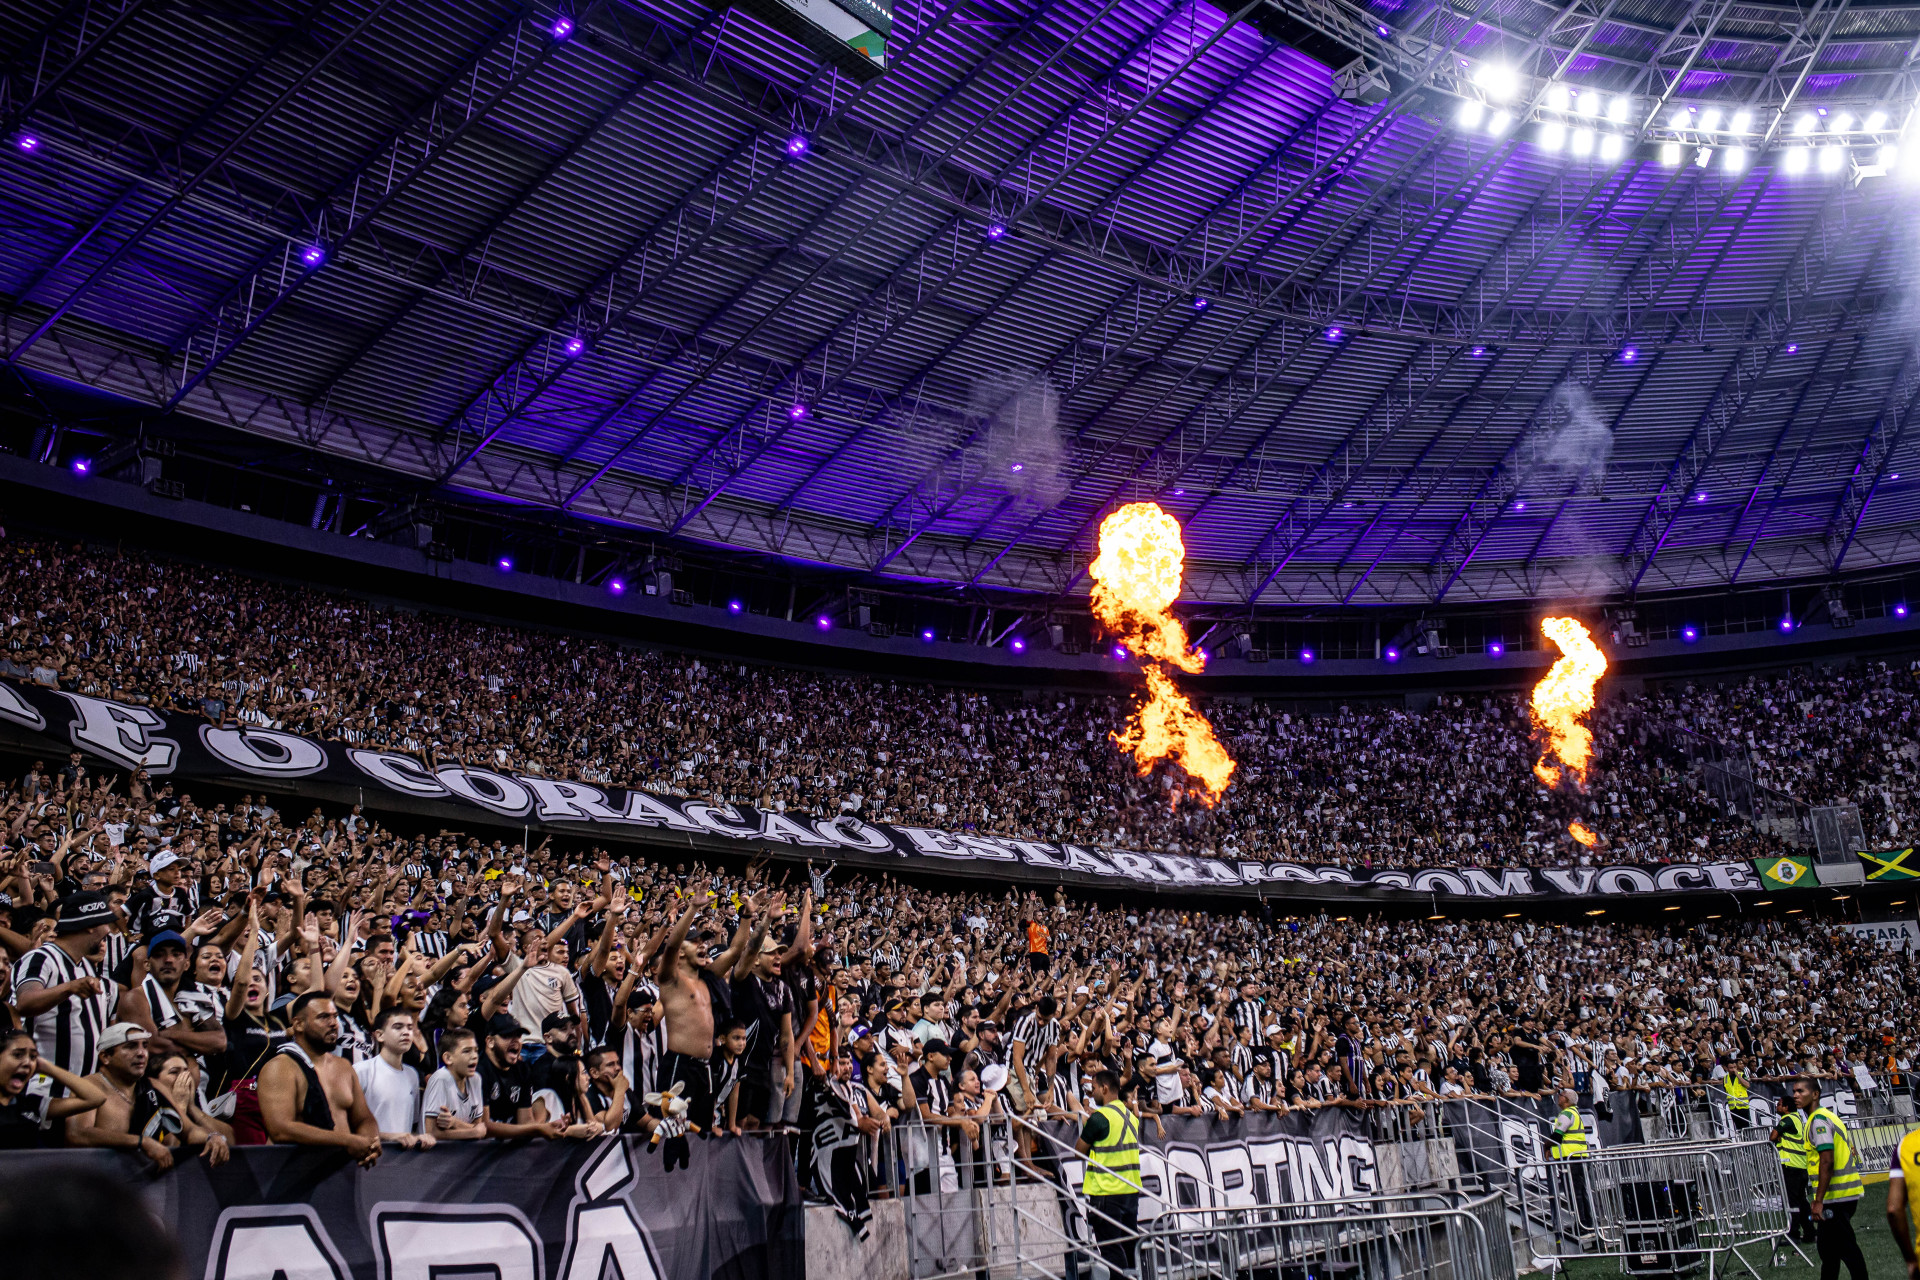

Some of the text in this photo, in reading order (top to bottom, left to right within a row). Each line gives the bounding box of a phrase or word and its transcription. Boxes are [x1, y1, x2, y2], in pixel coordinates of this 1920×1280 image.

[54, 690, 181, 775] E
[199, 724, 328, 777] O
[1856, 922, 1912, 940] CEARÁ
